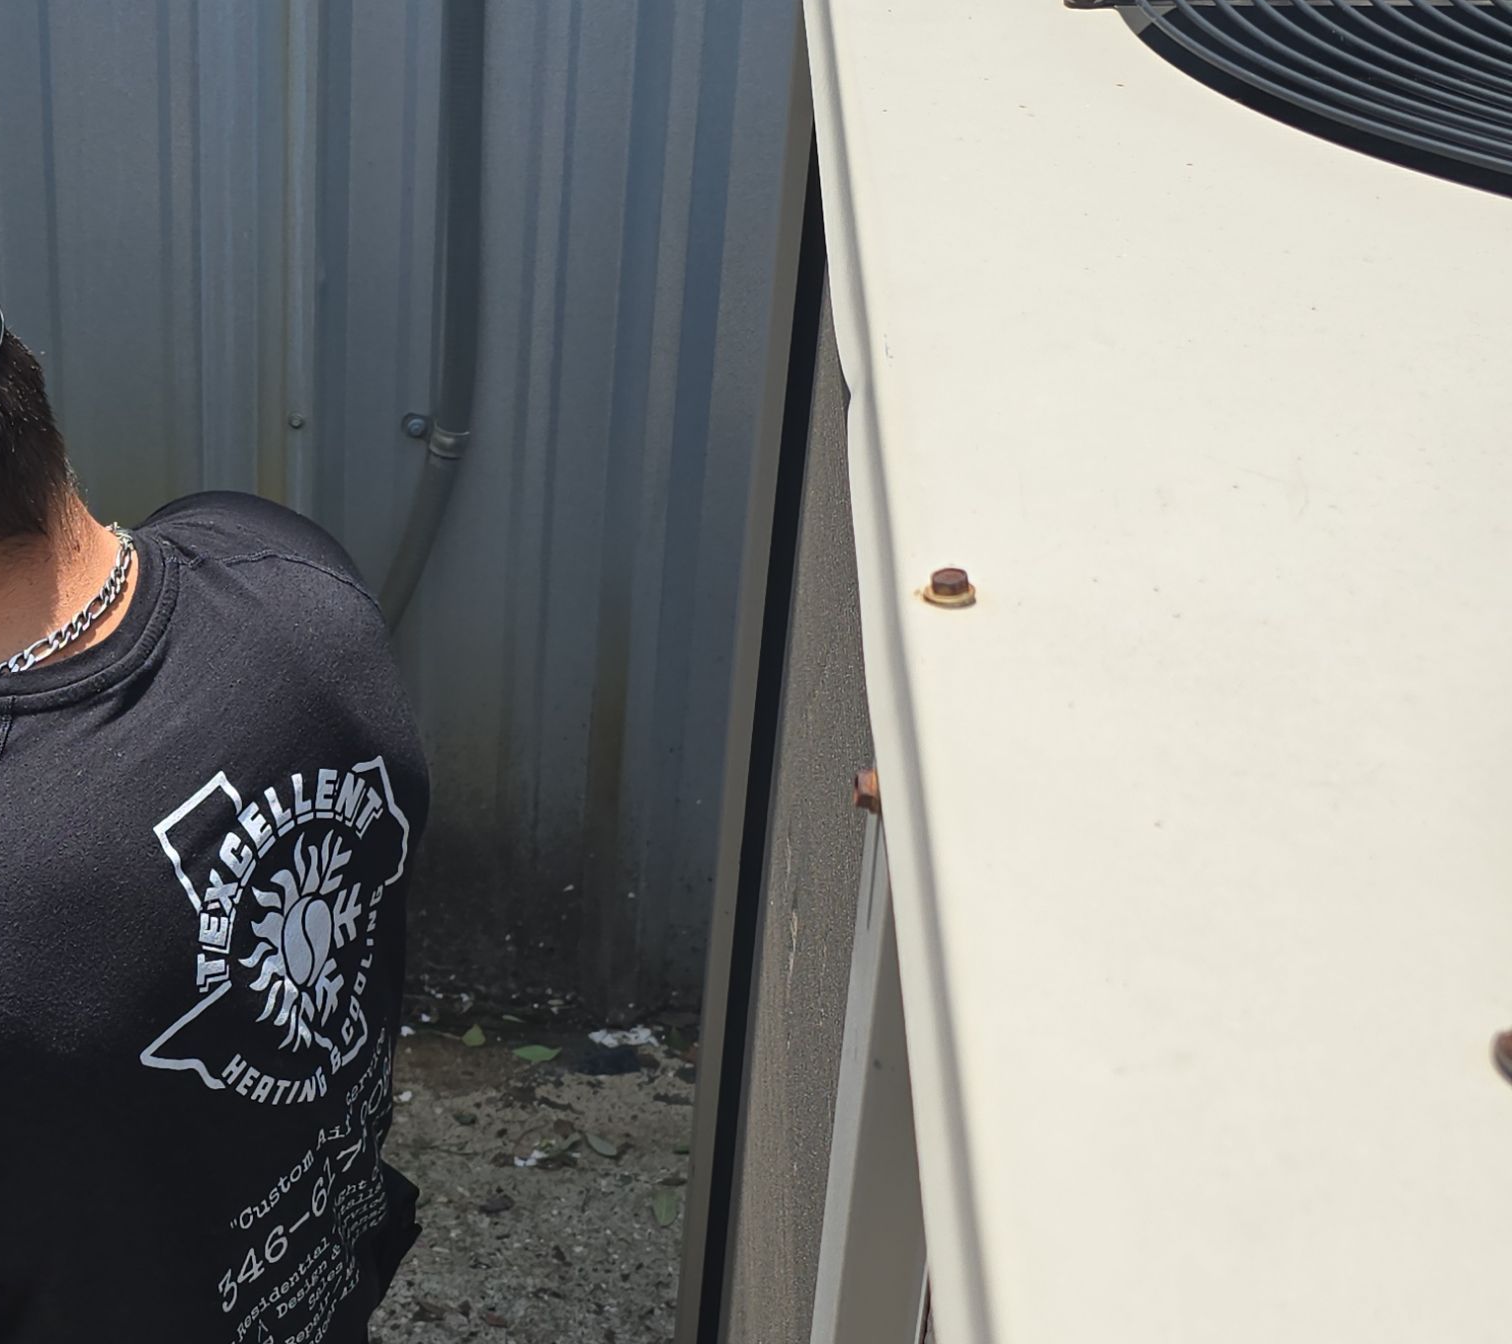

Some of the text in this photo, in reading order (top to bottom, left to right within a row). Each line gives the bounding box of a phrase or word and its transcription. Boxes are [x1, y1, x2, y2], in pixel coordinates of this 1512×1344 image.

[196, 768, 384, 993] TEXCELLENT
[221, 1053, 328, 1105] HEATING
[341, 884, 384, 1045] COOLING
[236, 1236, 330, 1343] Residential
[276, 1259, 328, 1319] Design
[308, 1262, 343, 1312] Sales
